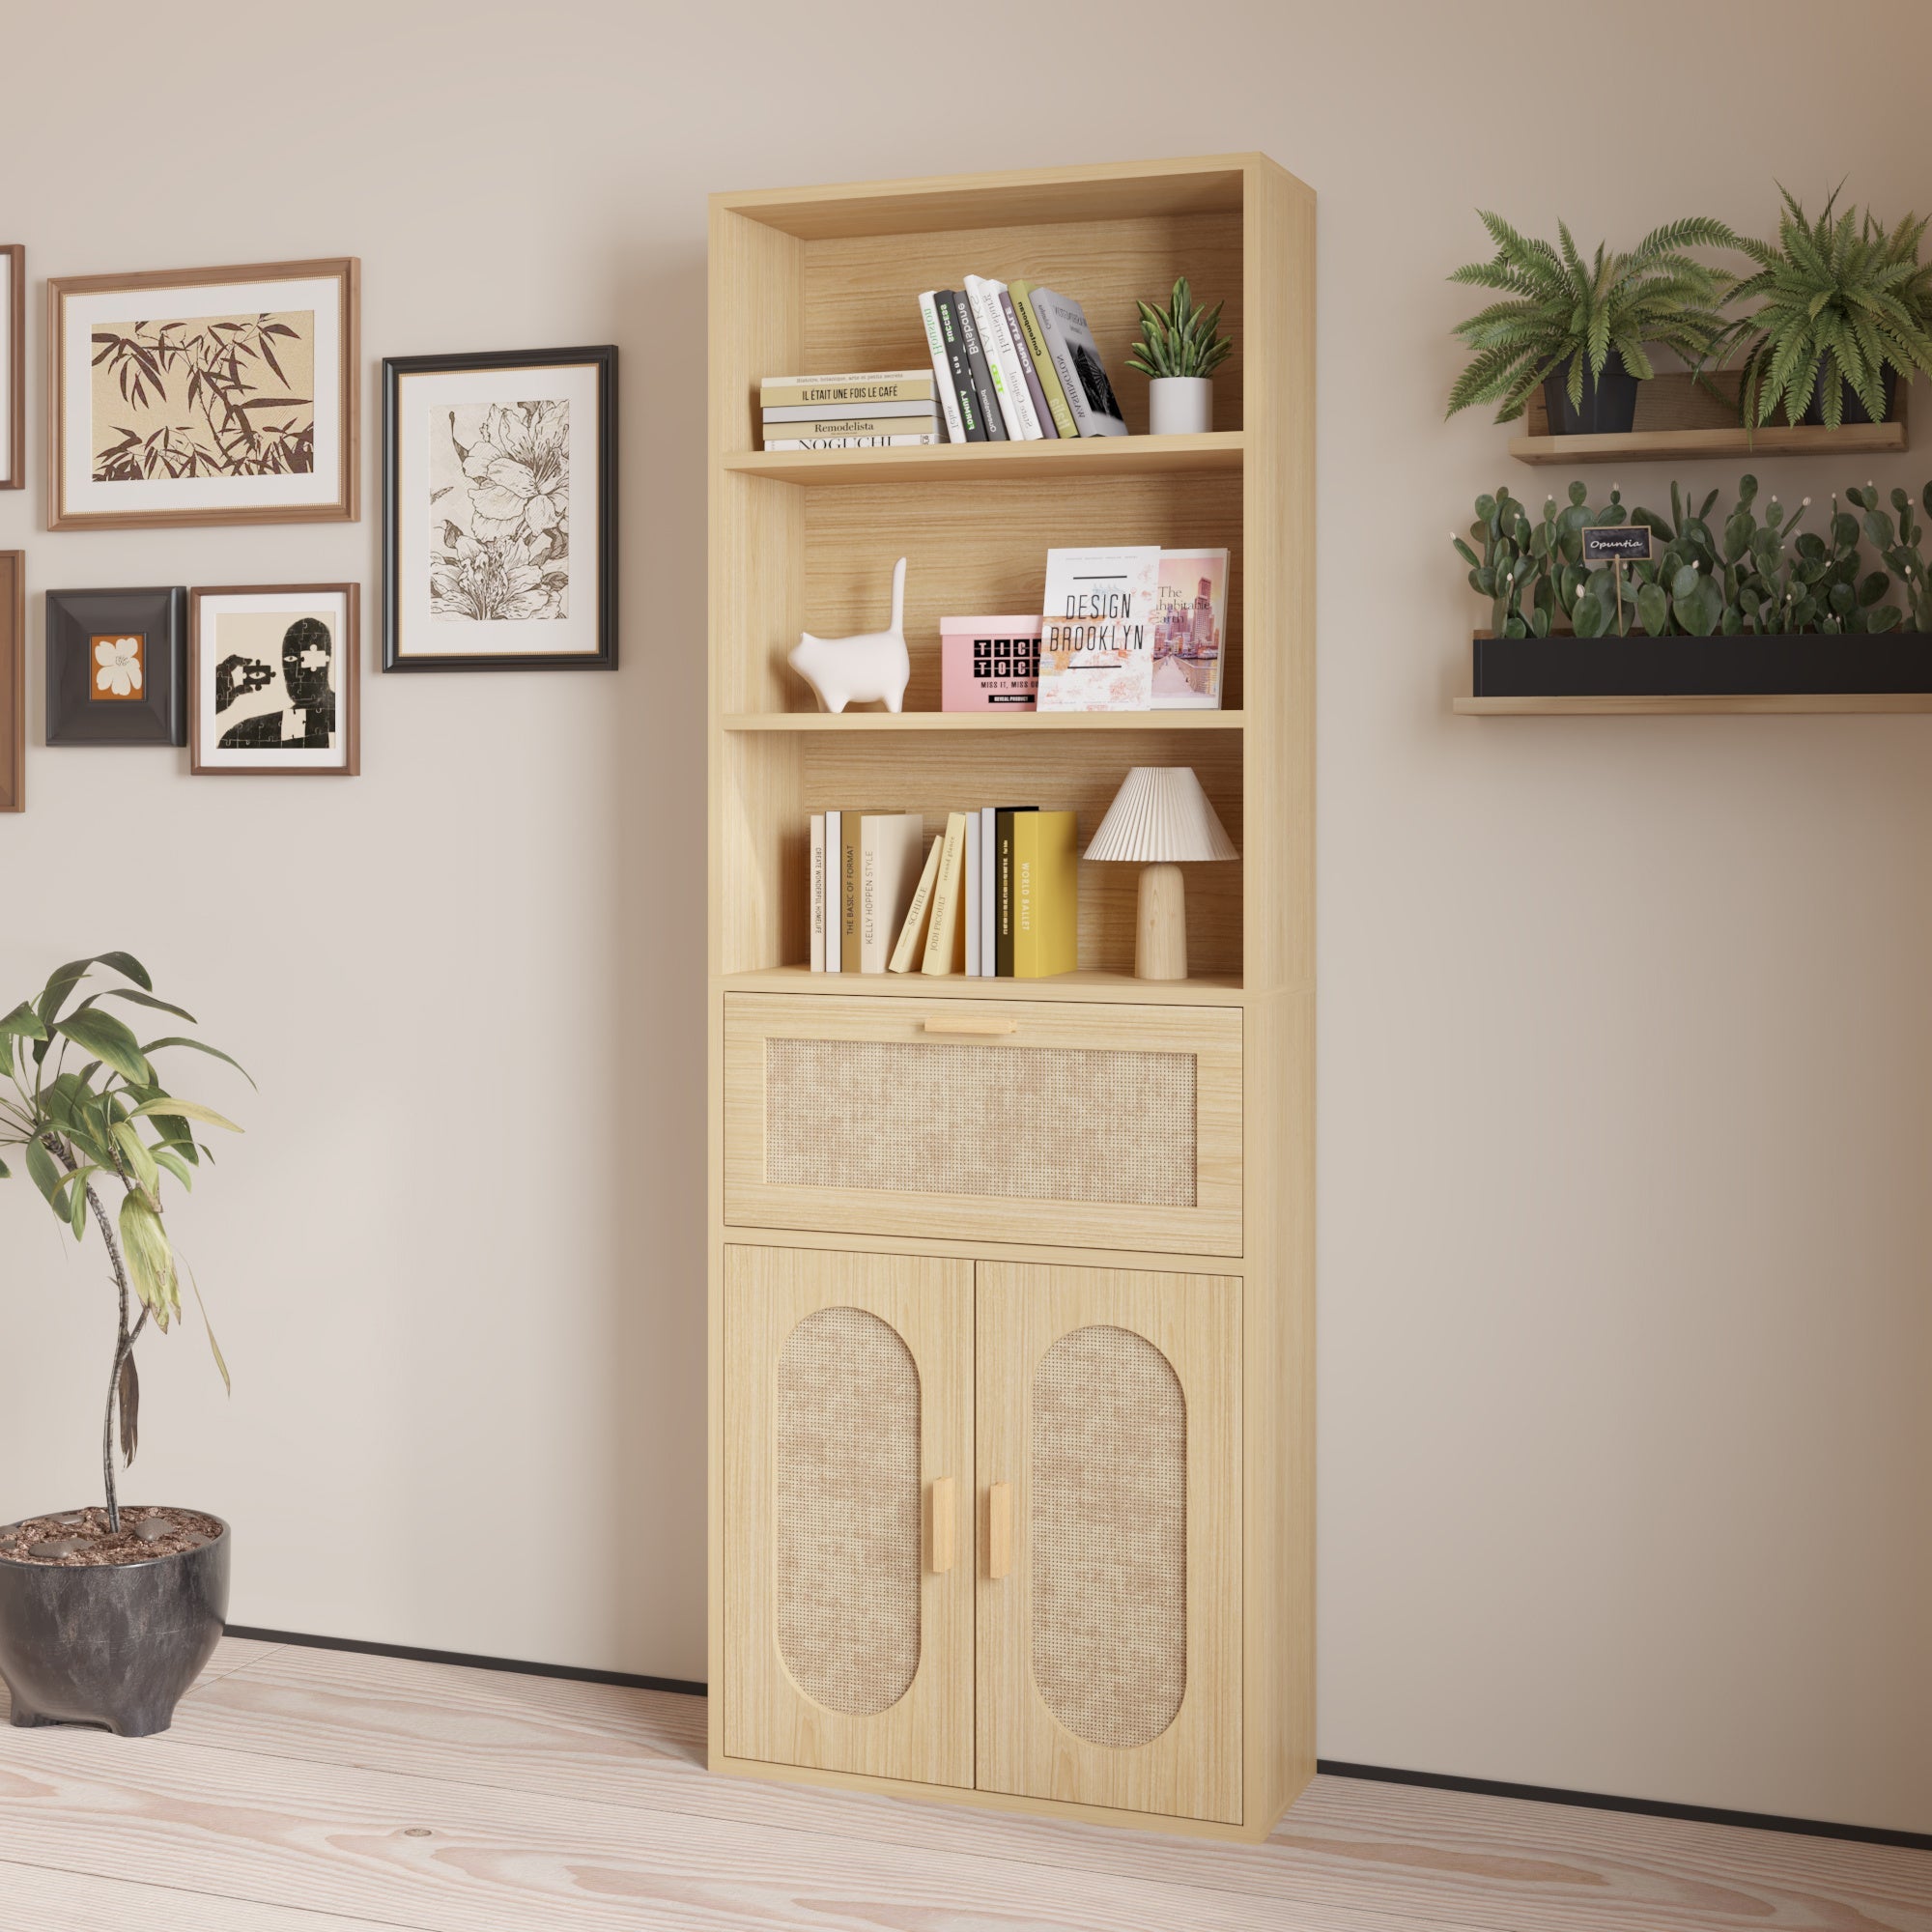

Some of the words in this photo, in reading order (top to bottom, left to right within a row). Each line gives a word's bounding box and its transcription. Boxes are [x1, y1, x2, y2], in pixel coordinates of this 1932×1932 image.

[802, 390, 809, 401] IL
[810, 387, 831, 401] ÉTAIT
[833, 389, 848, 400] UNE
[849, 387, 867, 399] FOIS
[867, 387, 877, 398] LE
[878, 384, 898, 397] CAFÉ
[814, 422, 874, 434] Remodelista
[1590, 539, 1643, 550] Opuntia
[1157, 585, 1182, 598] The
[1065, 593, 1131, 620] DESIGN
[1049, 625, 1144, 652] BROOKLYN
[978, 661, 1040, 675] TOC
[847, 881, 854, 893] OF
[1021, 863, 1030, 895] WORLD
[908, 887, 927, 926] SCHIELE
[933, 895, 946, 931] PICOULT
[1021, 898, 1030, 930] BALLET
[930, 931, 939, 952] JODI
